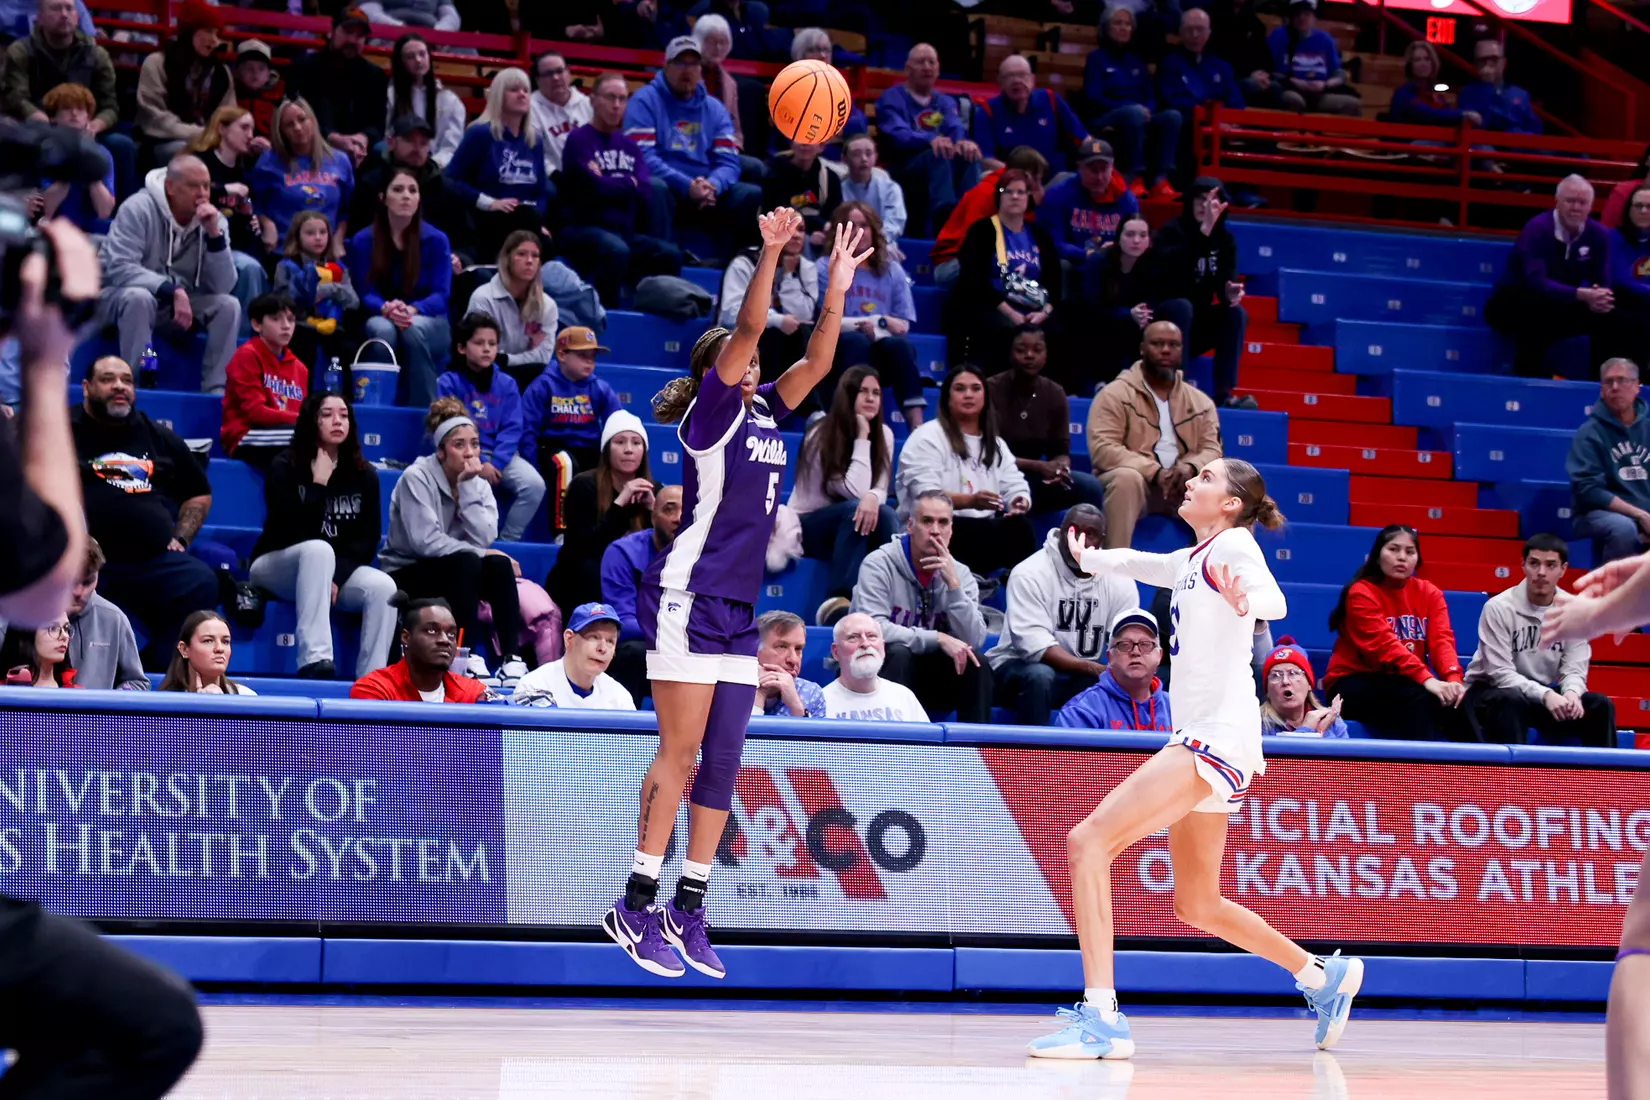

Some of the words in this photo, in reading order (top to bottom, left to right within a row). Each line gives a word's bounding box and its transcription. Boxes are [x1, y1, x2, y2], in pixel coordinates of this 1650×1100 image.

[1426, 16, 1457, 44] EXIT
[1006, 250, 1039, 266] ANSA
[551, 404, 580, 415] CHALK
[764, 472, 780, 516] 5
[304, 777, 379, 823] OF
[1411, 800, 1650, 852] ROOFING
[41, 822, 270, 879] HEALTH
[291, 828, 492, 884] SYSTEM
[1234, 850, 1460, 900] KANSAS
